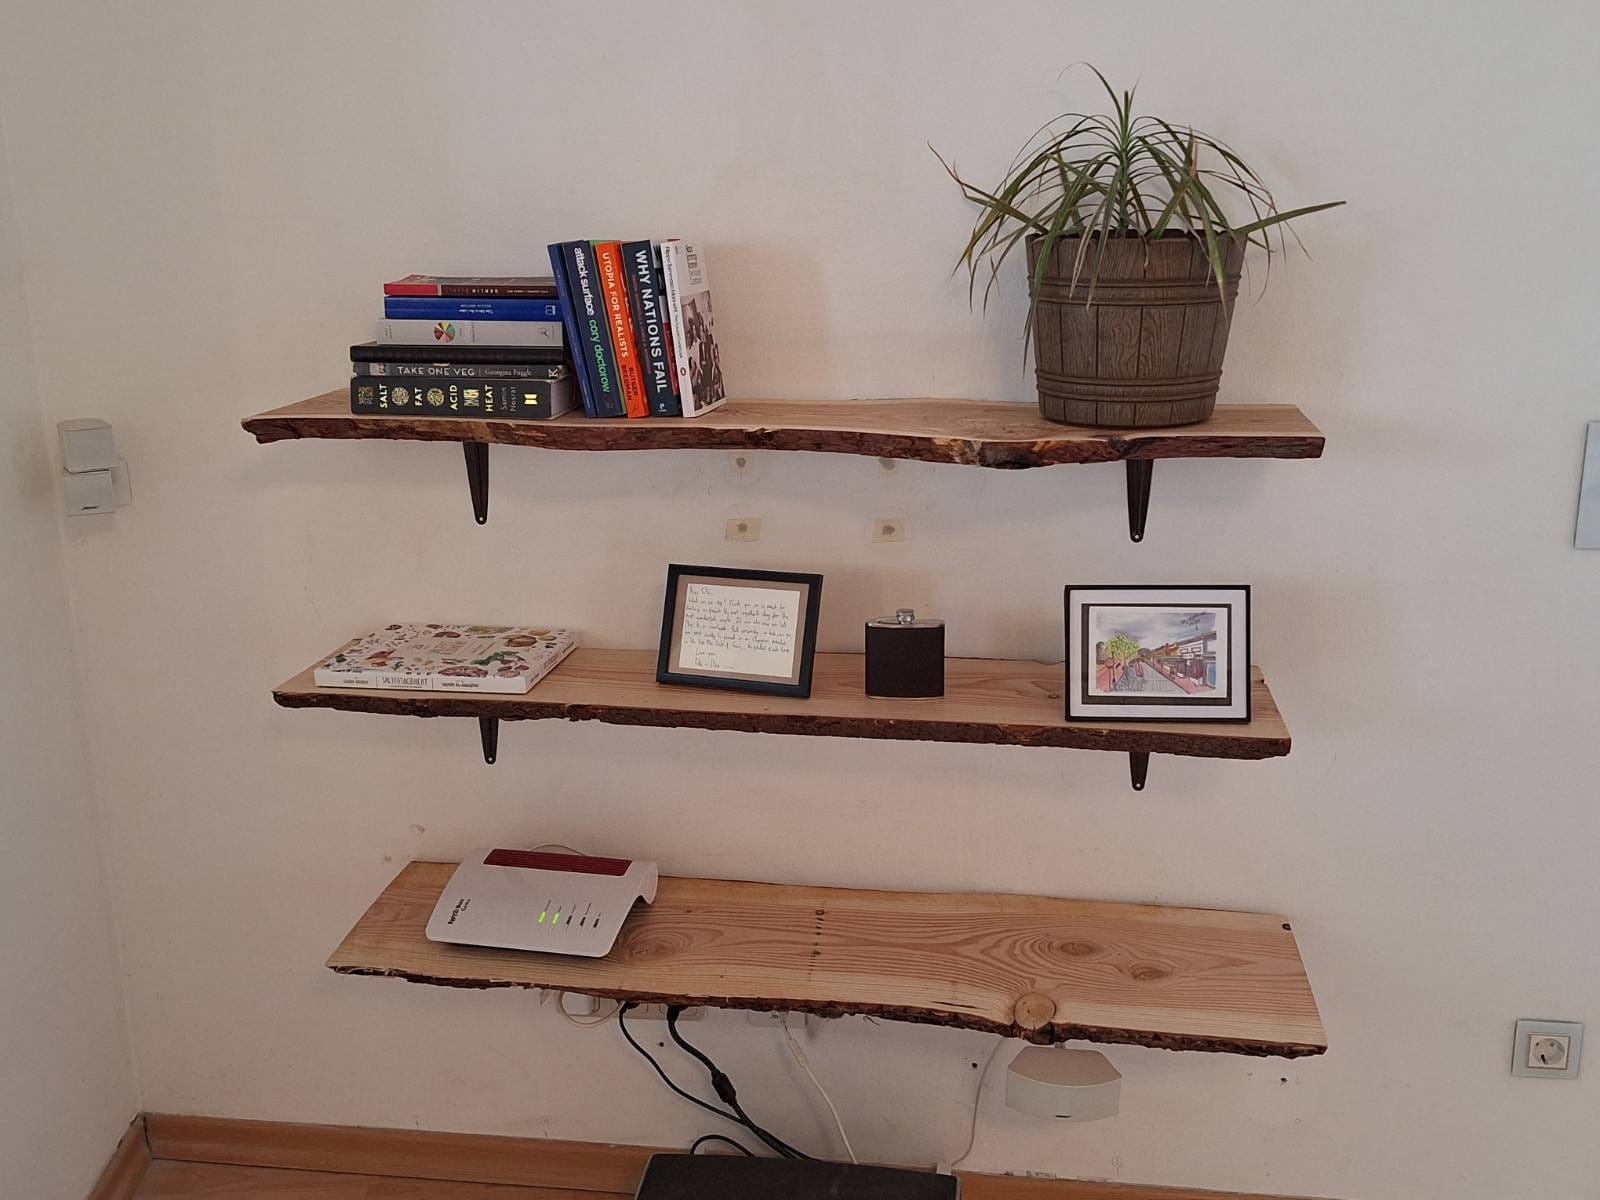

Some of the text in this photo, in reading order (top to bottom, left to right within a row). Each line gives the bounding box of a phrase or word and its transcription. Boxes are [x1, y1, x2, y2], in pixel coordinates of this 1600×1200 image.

[574, 247, 595, 316] attack surface
[635, 249, 651, 286] WHY
[602, 252, 629, 358] UTOPIA FOR REALISTS
[641, 288, 662, 359] NATIONS
[397, 366, 475, 376] TAKE ONE VEG
[589, 319, 611, 393] cory doctorow
[653, 361, 668, 394] FAIL
[378, 384, 388, 408] SALT
[414, 387, 423, 406] FAT
[449, 384, 458, 410] ACID
[484, 384, 494, 412] HEAT
